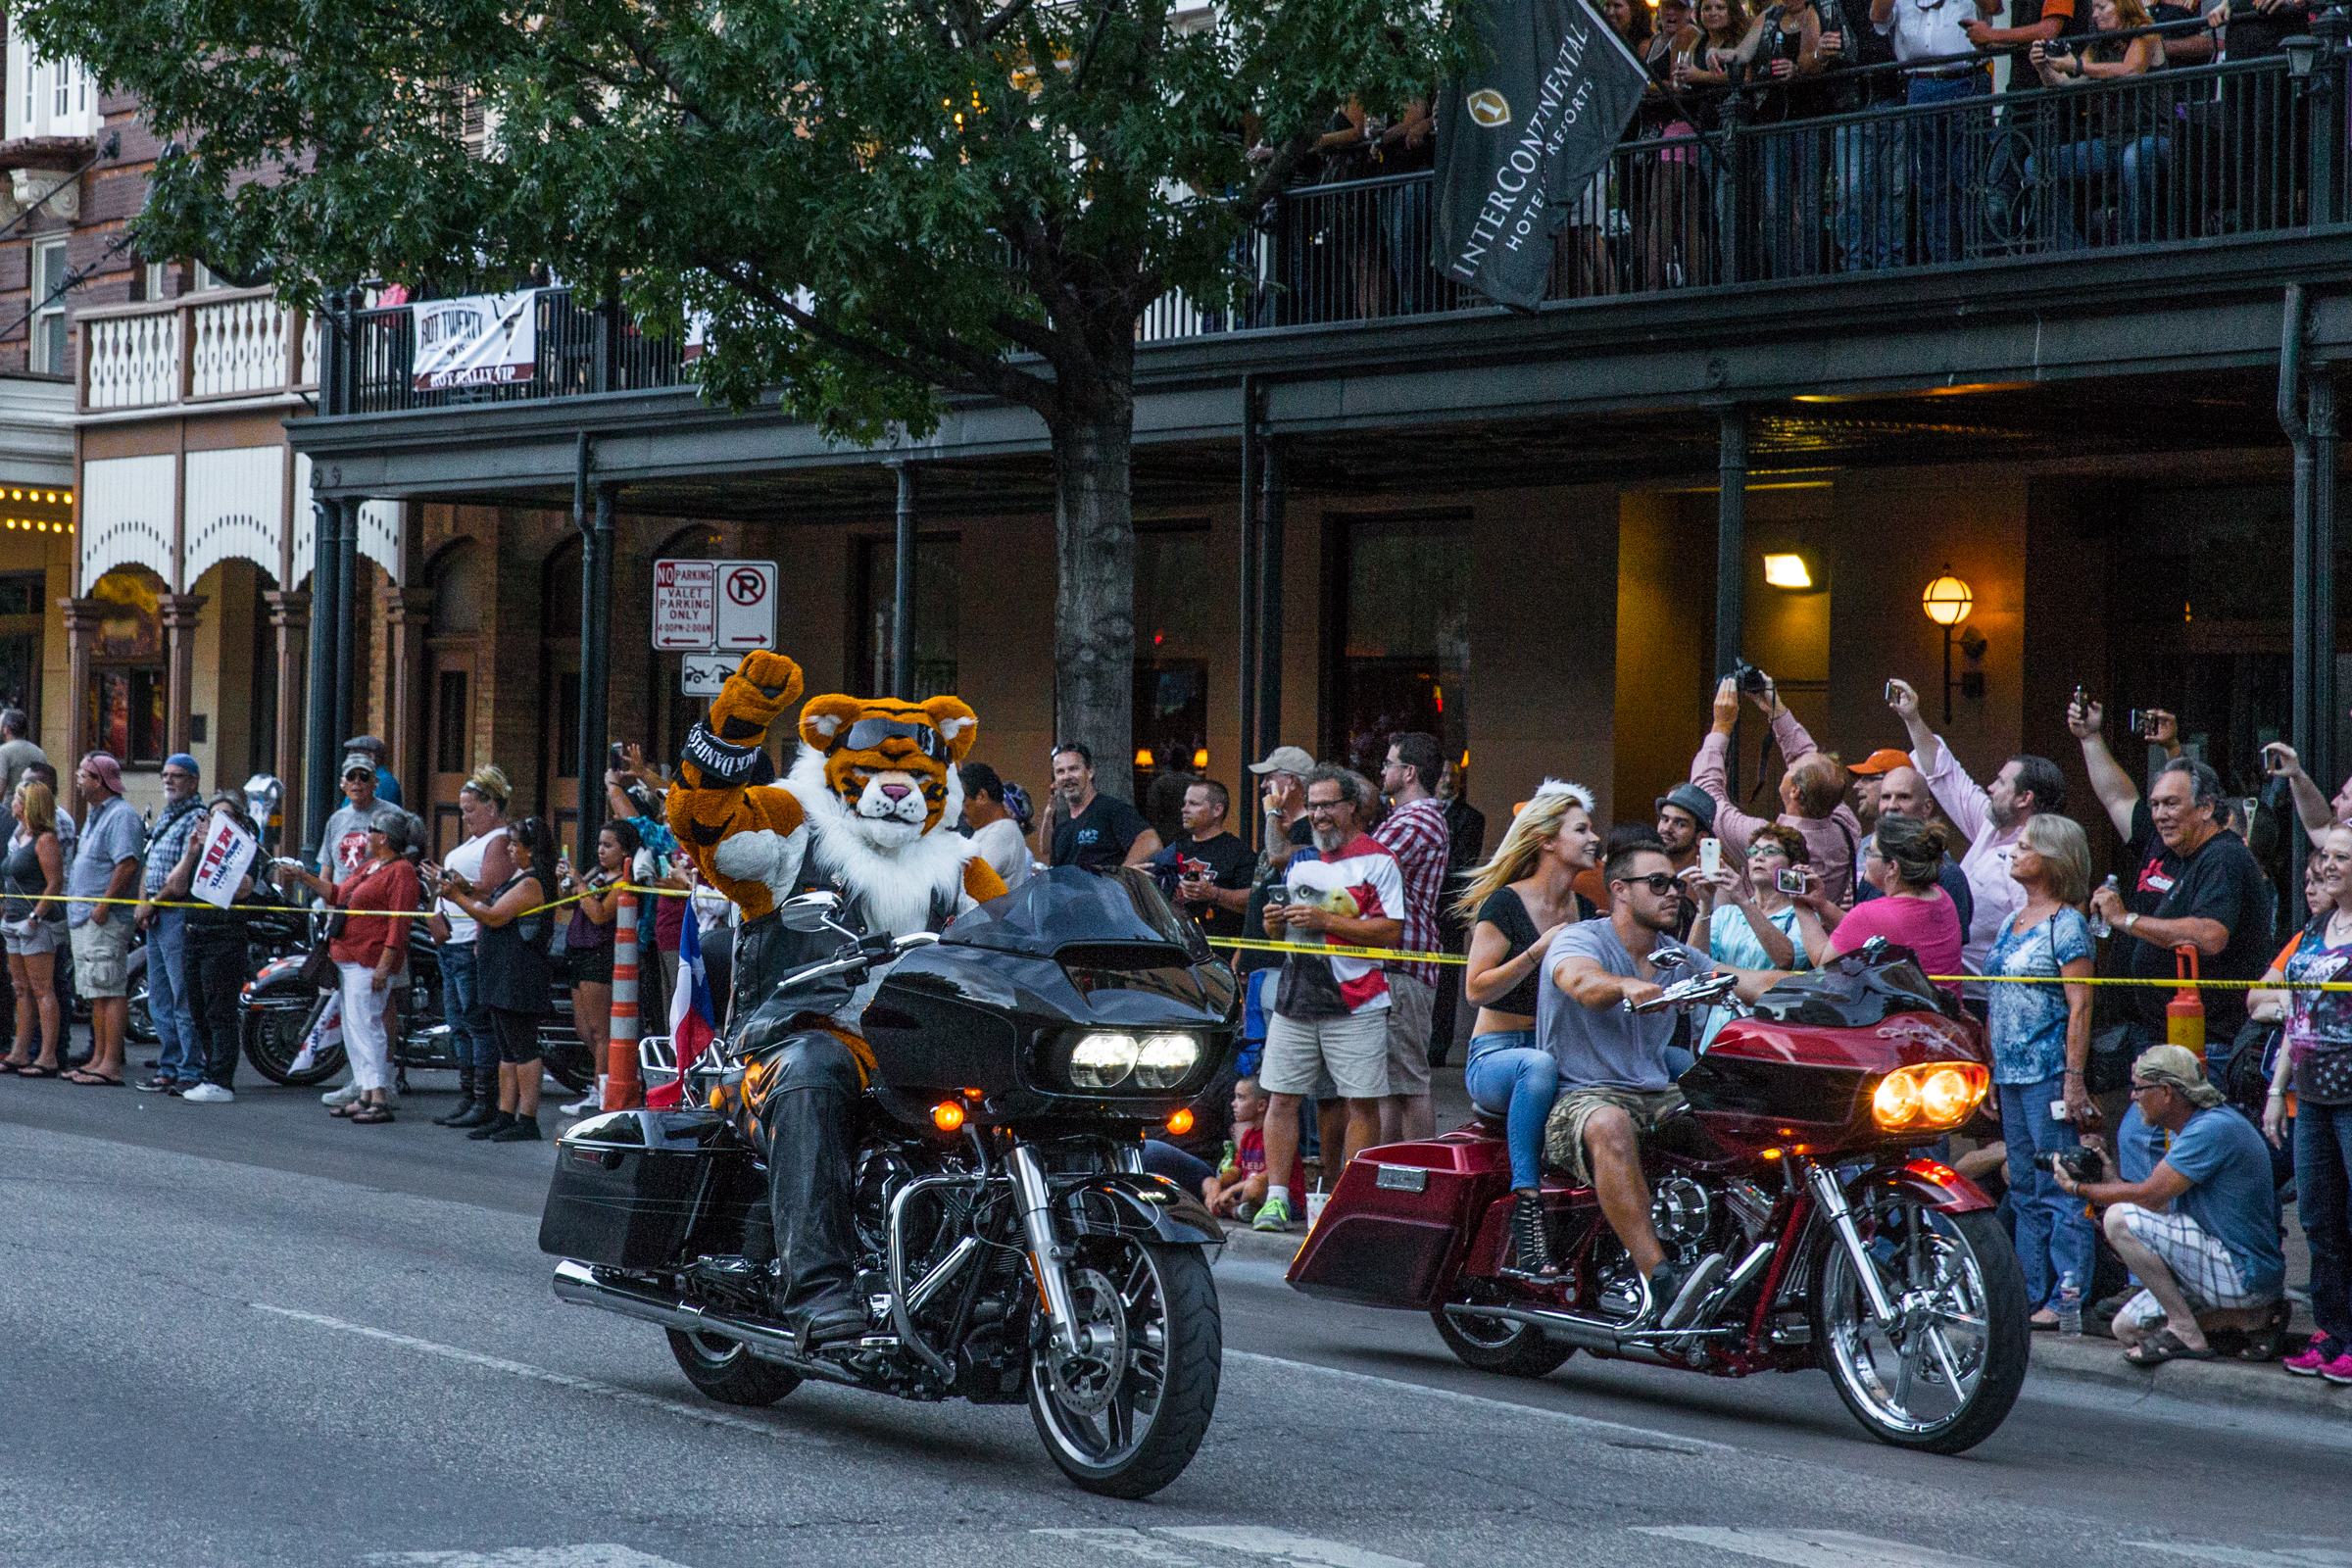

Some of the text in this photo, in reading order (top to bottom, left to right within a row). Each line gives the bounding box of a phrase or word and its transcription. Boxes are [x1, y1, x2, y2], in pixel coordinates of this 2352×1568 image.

[1545, 77, 1593, 155] RESORTS
[1452, 24, 1588, 277] INTERCONTNENTAL
[495, 366, 515, 382] VIP
[658, 566, 712, 584] NO PARKING
[667, 588, 703, 599] VALET
[660, 599, 710, 610] PARKING
[669, 610, 700, 620] ONLY
[735, 746, 761, 772] JACK
